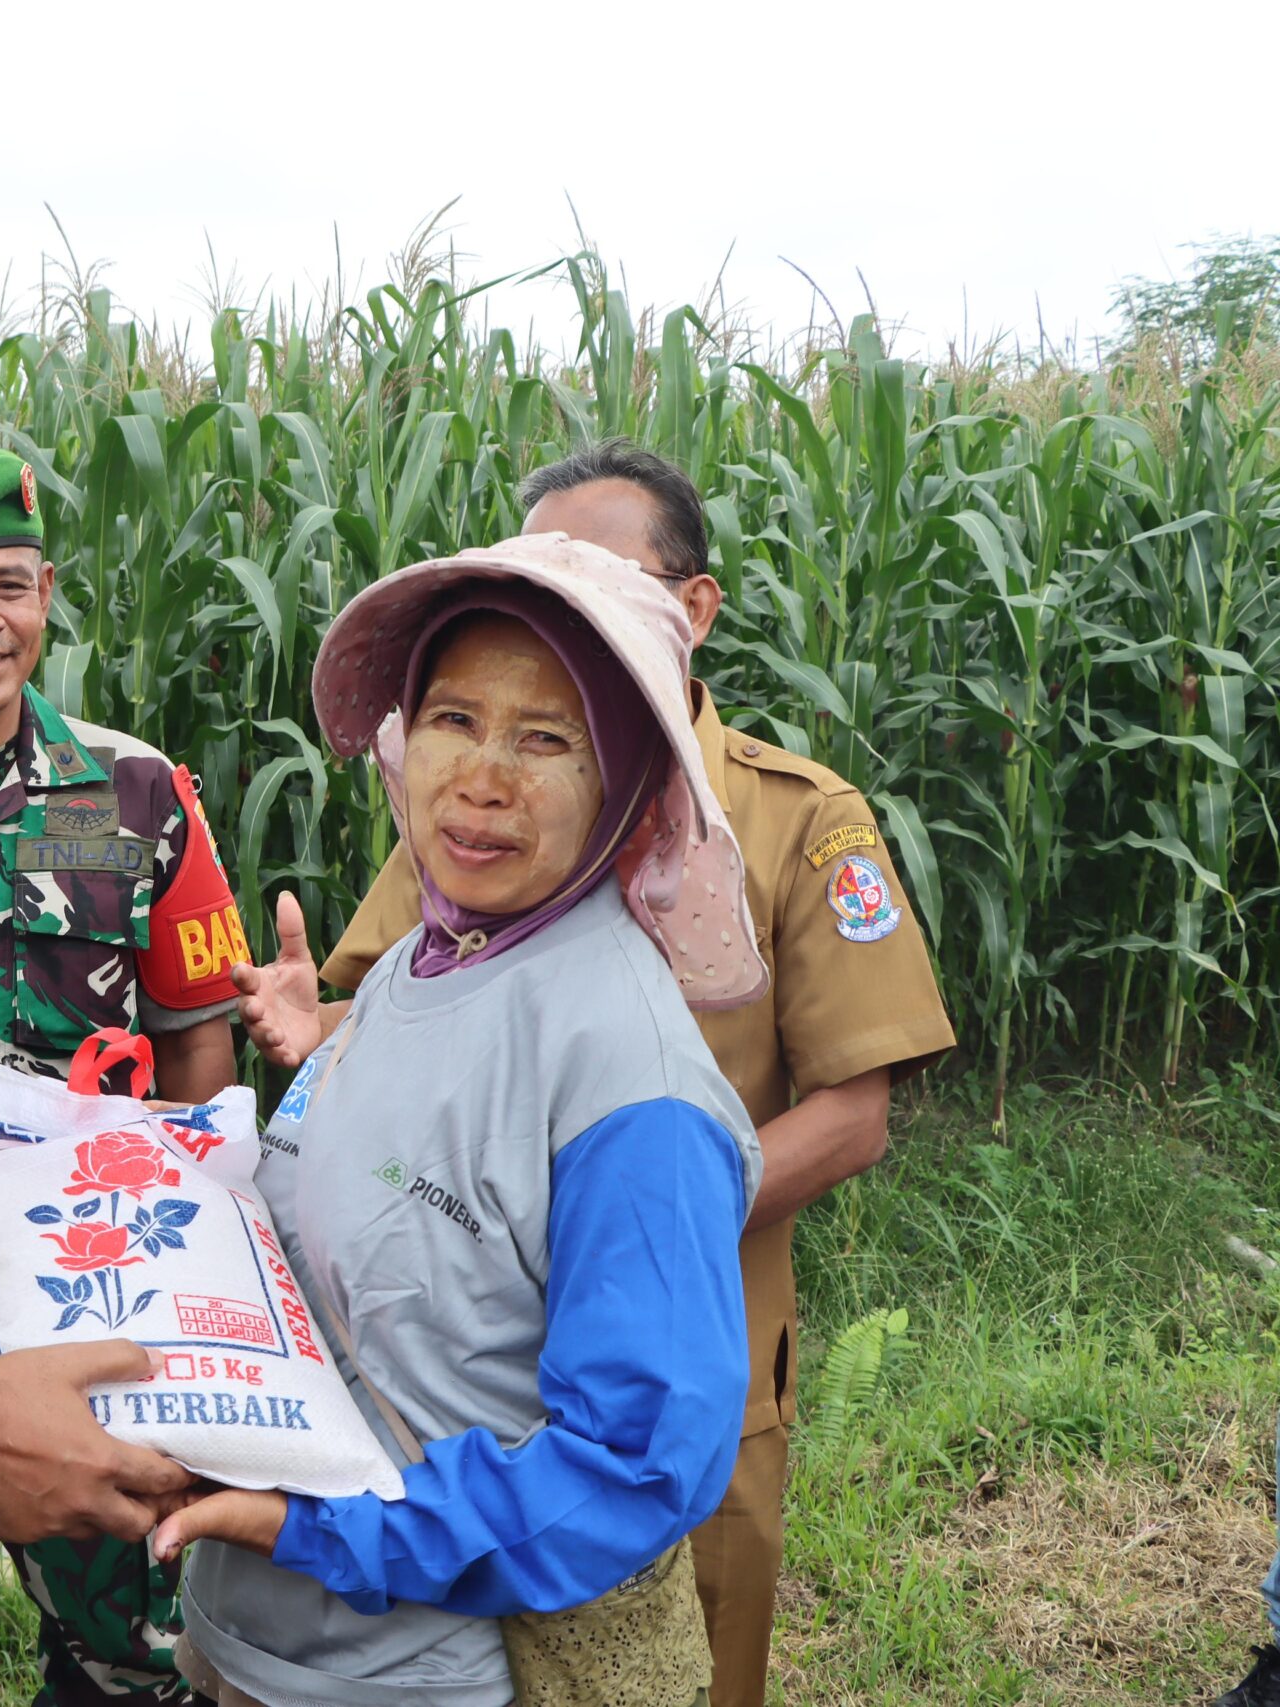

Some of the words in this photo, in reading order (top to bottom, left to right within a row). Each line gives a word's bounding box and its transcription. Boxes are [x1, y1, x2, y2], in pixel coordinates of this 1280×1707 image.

[31, 841, 143, 870] TNI-AD
[820, 844, 836, 860] DELI
[836, 834, 867, 847] SERDANG
[177, 904, 252, 981] BAB
[199, 1311, 207, 1319] 2
[214, 1313, 222, 1321] 3
[230, 1315, 237, 1323] 4
[267, 1256, 324, 1366] BERAS
[185, 1323, 193, 1331] 7
[200, 1357, 216, 1378] 5
[224, 1358, 263, 1385] Kg
[124, 1393, 312, 1430] TERBAIK
